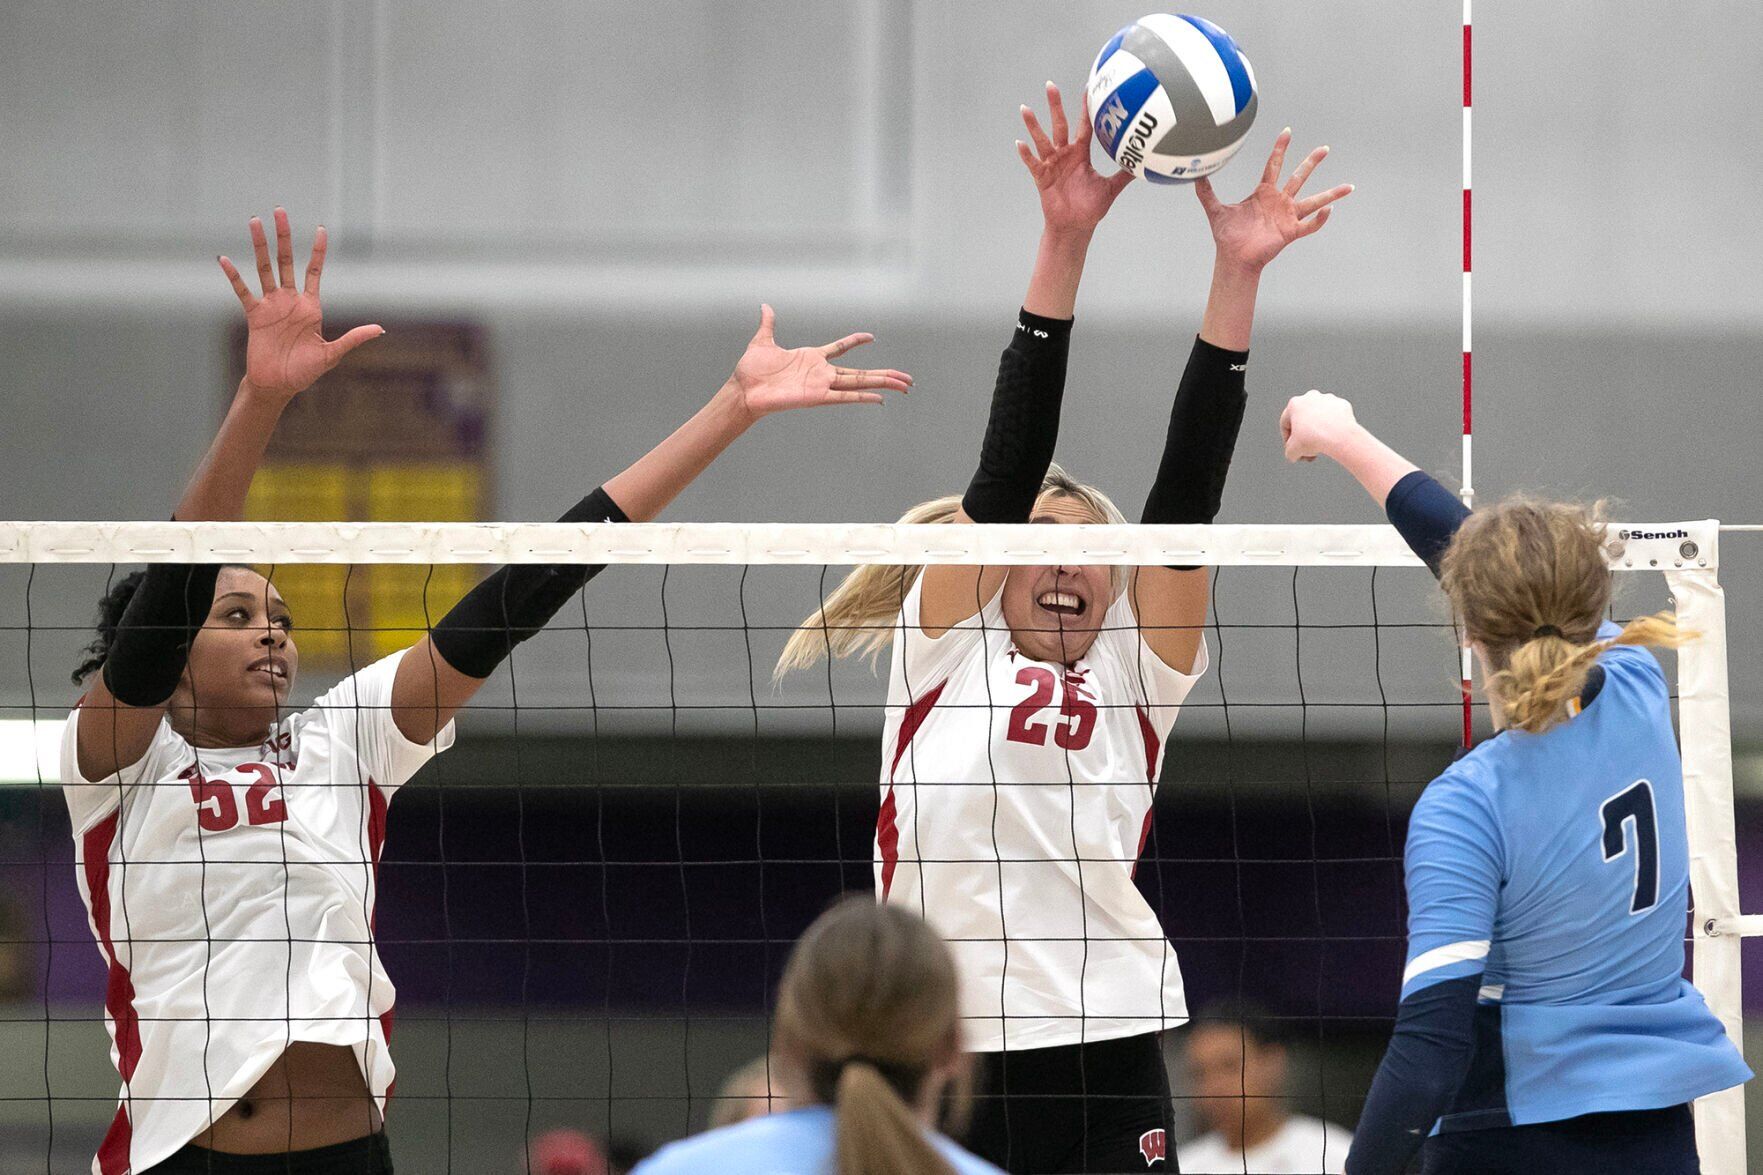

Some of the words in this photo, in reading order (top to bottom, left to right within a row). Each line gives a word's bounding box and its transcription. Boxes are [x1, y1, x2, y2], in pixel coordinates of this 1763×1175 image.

[1630, 530, 1688, 540] Senoh
[1006, 666, 1098, 751] 25
[187, 762, 289, 832] 52
[1599, 778, 1661, 916] 7
[1139, 1128, 1165, 1167] W
